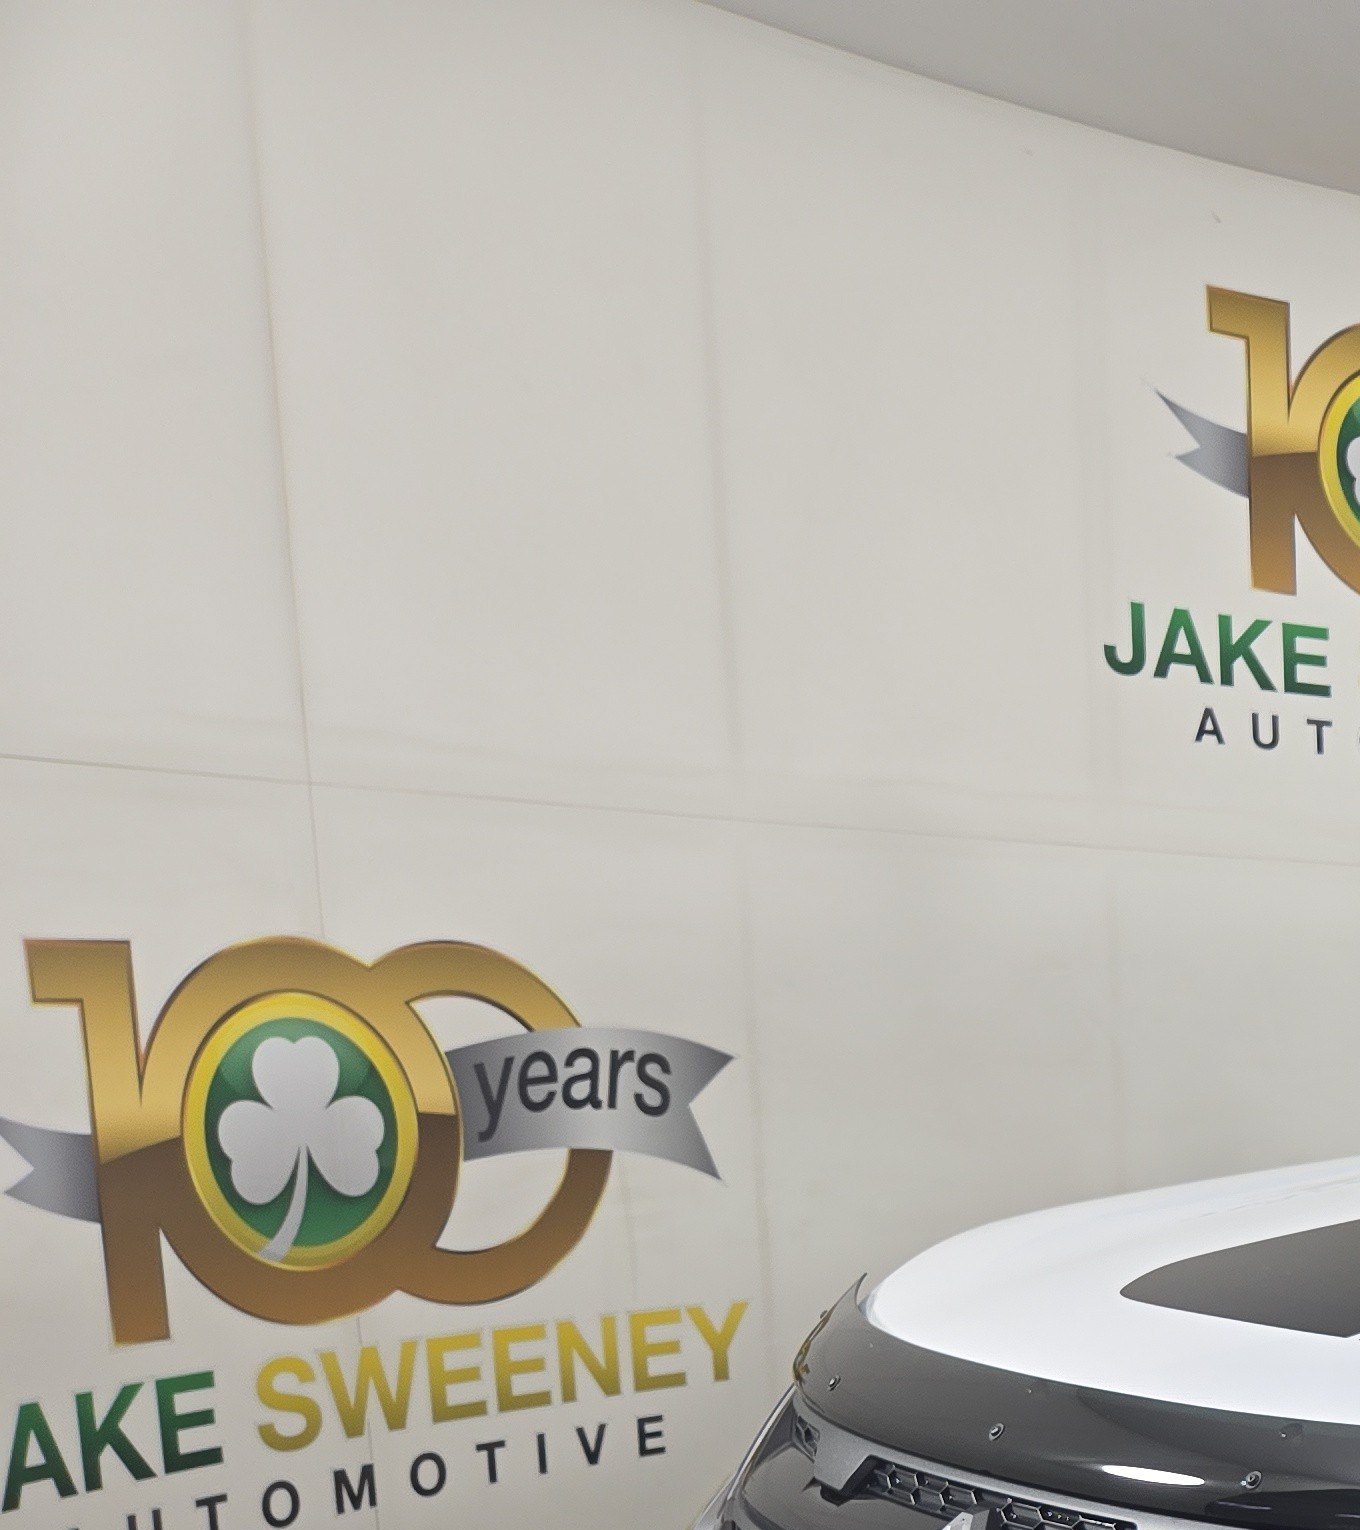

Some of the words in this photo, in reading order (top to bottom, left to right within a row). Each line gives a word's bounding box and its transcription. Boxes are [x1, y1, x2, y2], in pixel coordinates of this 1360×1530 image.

[1104, 601, 1331, 698] JAKE
[473, 1048, 673, 1142] years
[255, 1301, 748, 1452] SWEENEY
